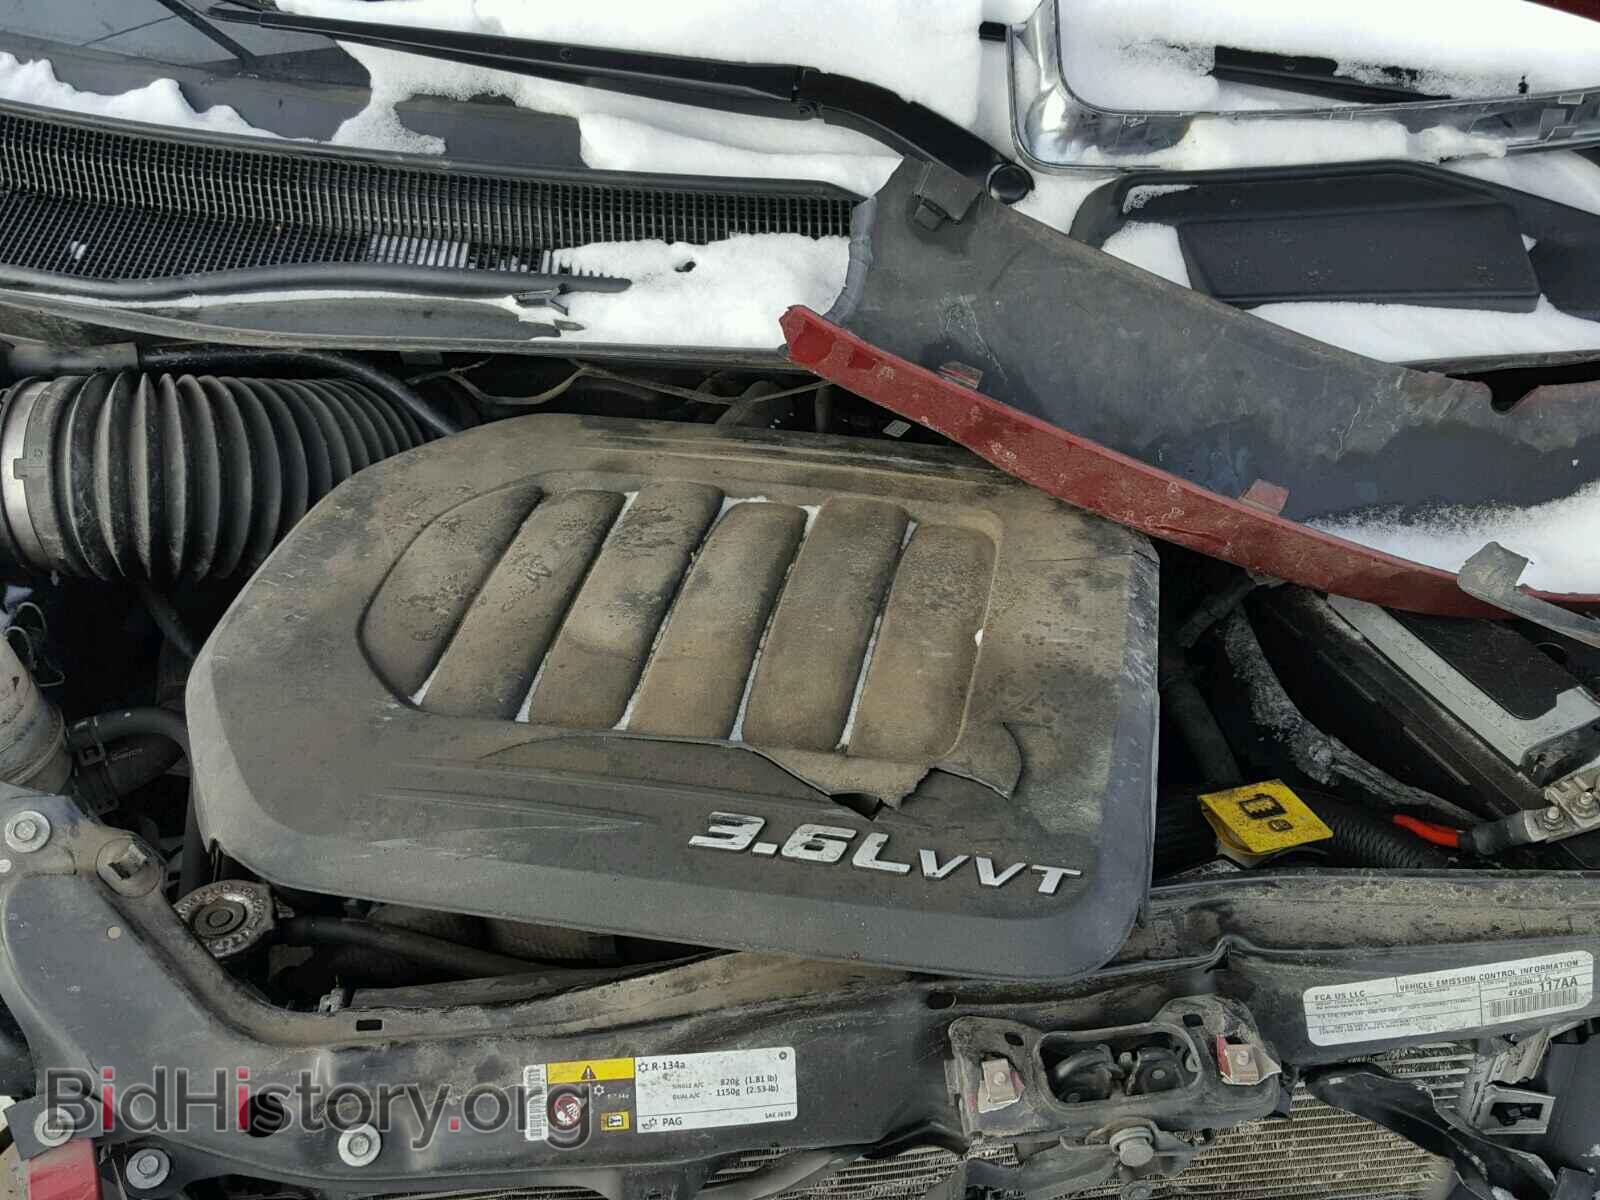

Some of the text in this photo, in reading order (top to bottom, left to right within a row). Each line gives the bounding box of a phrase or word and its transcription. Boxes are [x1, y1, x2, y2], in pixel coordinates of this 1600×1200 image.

[688, 811, 1082, 896] 3.6L VVT
[1399, 981, 1433, 992] VEHICLE
[1436, 975, 1476, 987] EMISSION
[1479, 969, 1517, 981] CONTROL
[1520, 960, 1578, 974] INFORMATION
[1539, 976, 1578, 992] 117AA
[1314, 990, 1366, 1001] FCA US LLC
[651, 1060, 686, 1071] R-134a
[720, 1078, 740, 1087] 820g
[716, 1088, 740, 1097] 1150g
[662, 1117, 682, 1126] PAG
